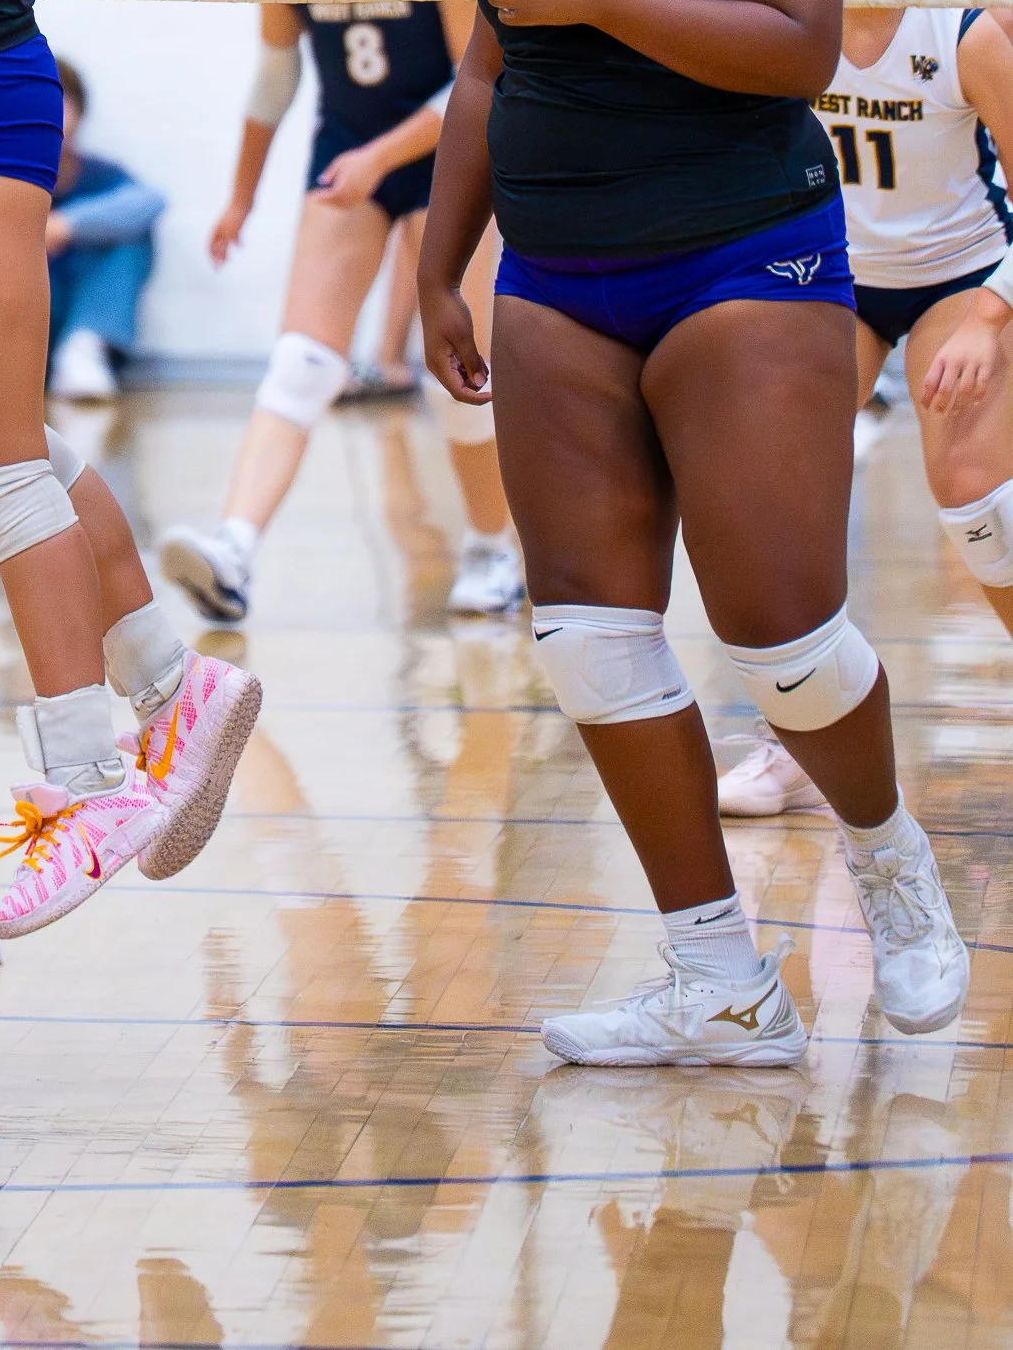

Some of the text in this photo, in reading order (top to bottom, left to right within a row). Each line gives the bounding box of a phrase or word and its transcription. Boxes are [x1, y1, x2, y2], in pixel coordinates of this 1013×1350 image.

[342, 20, 391, 88] 8
[855, 96, 924, 122] RANCH
[829, 123, 897, 191] 11
